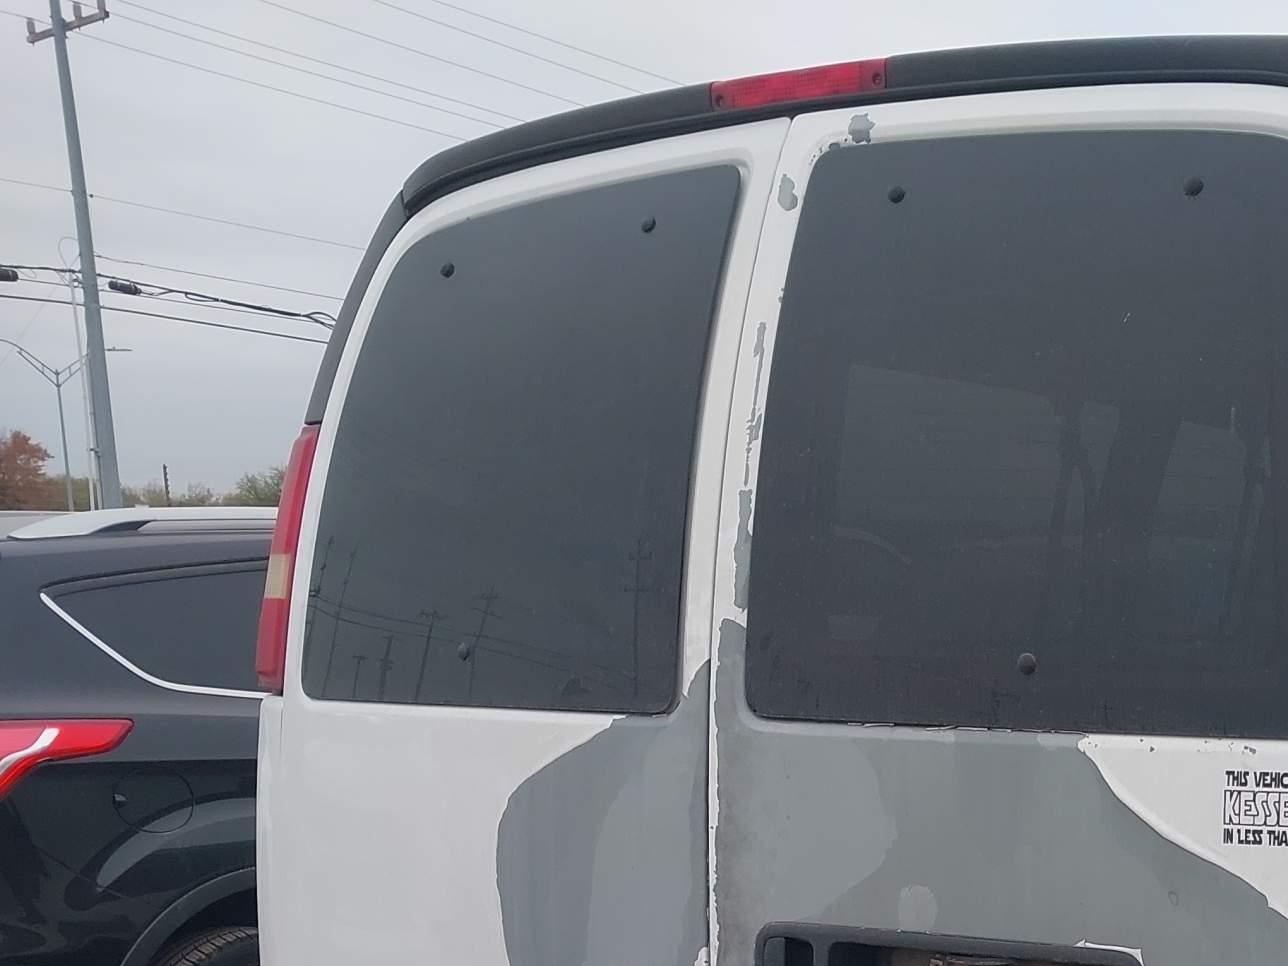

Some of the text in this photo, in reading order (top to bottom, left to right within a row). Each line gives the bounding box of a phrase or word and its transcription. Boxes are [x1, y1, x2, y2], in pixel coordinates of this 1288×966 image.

[1225, 770, 1249, 787] THIS
[1223, 828, 1234, 844] IN
[1237, 829, 1263, 845] LESS
